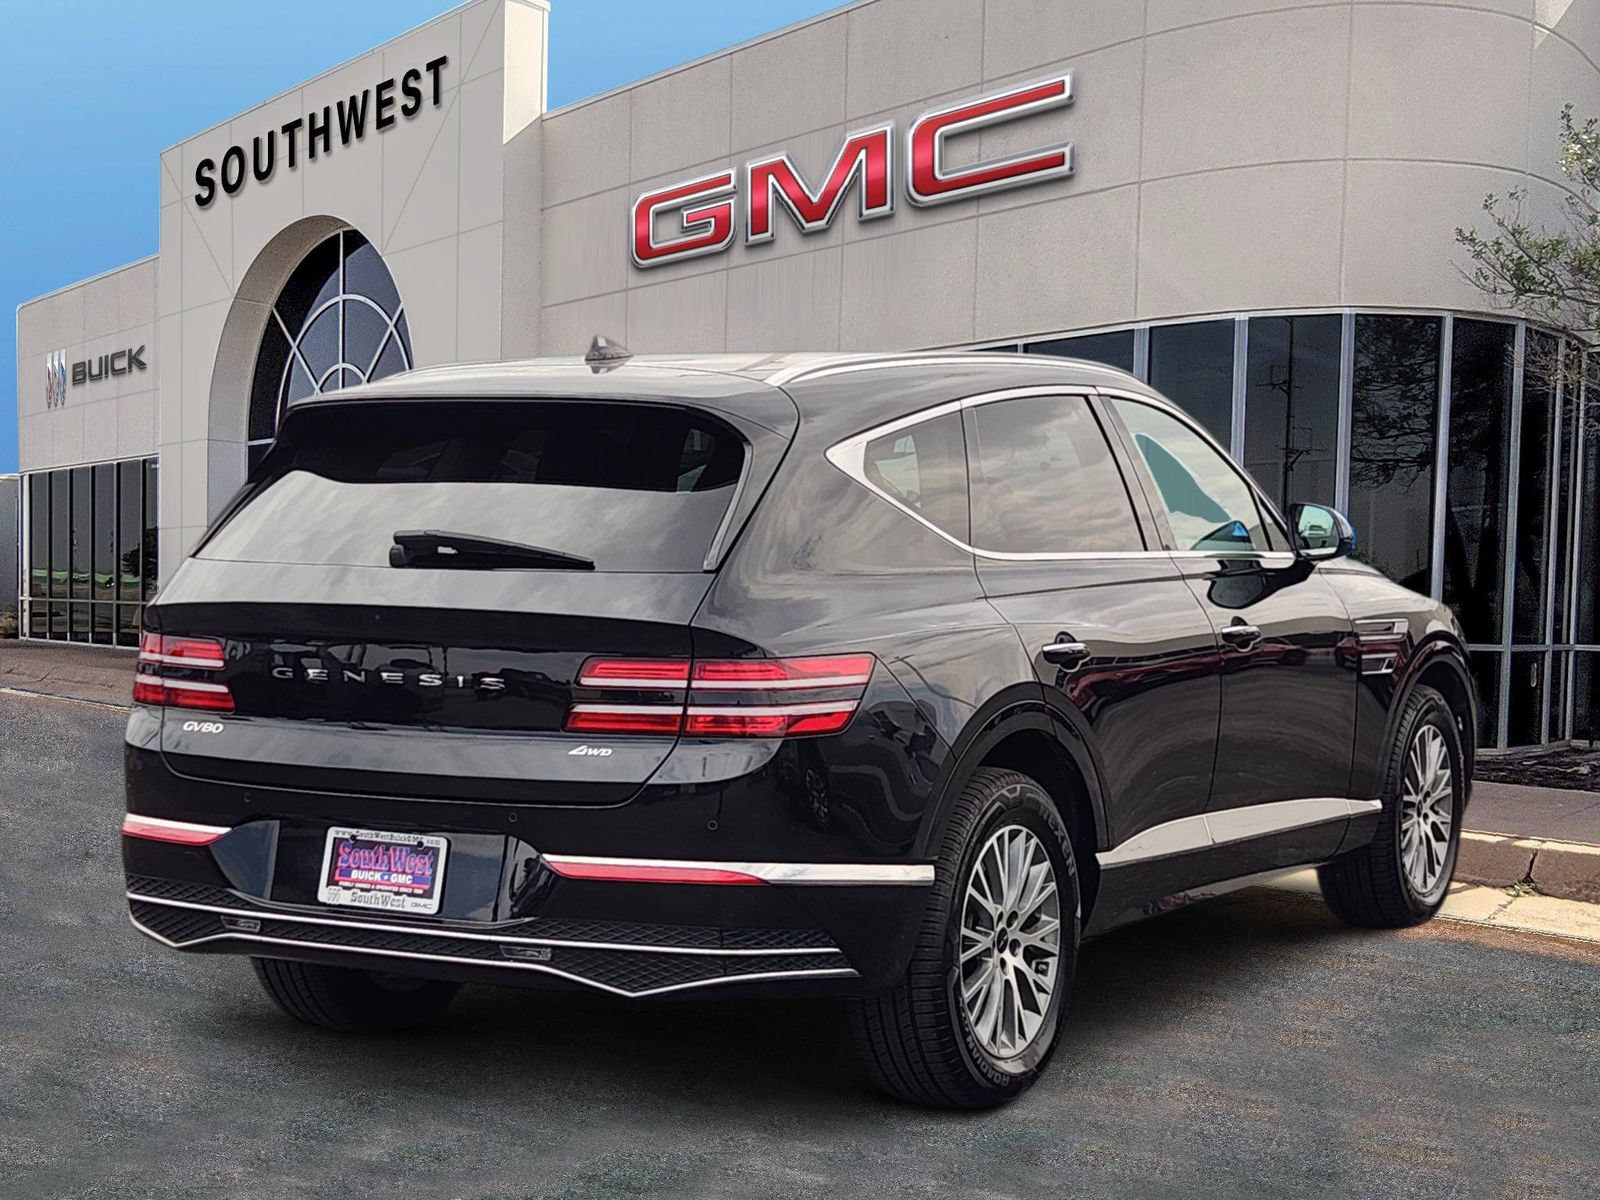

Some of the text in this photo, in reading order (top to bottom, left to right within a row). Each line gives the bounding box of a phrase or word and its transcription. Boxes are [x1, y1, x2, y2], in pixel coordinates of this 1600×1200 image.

[195, 55, 447, 207] SOUTHWEST
[631, 70, 1075, 268] GMC
[72, 345, 147, 385] BUICK
[272, 667, 505, 690] GENESIS
[183, 720, 224, 734] GV80
[1039, 803, 1075, 877] NEXEN
[351, 869, 413, 885] BUICK GMC
